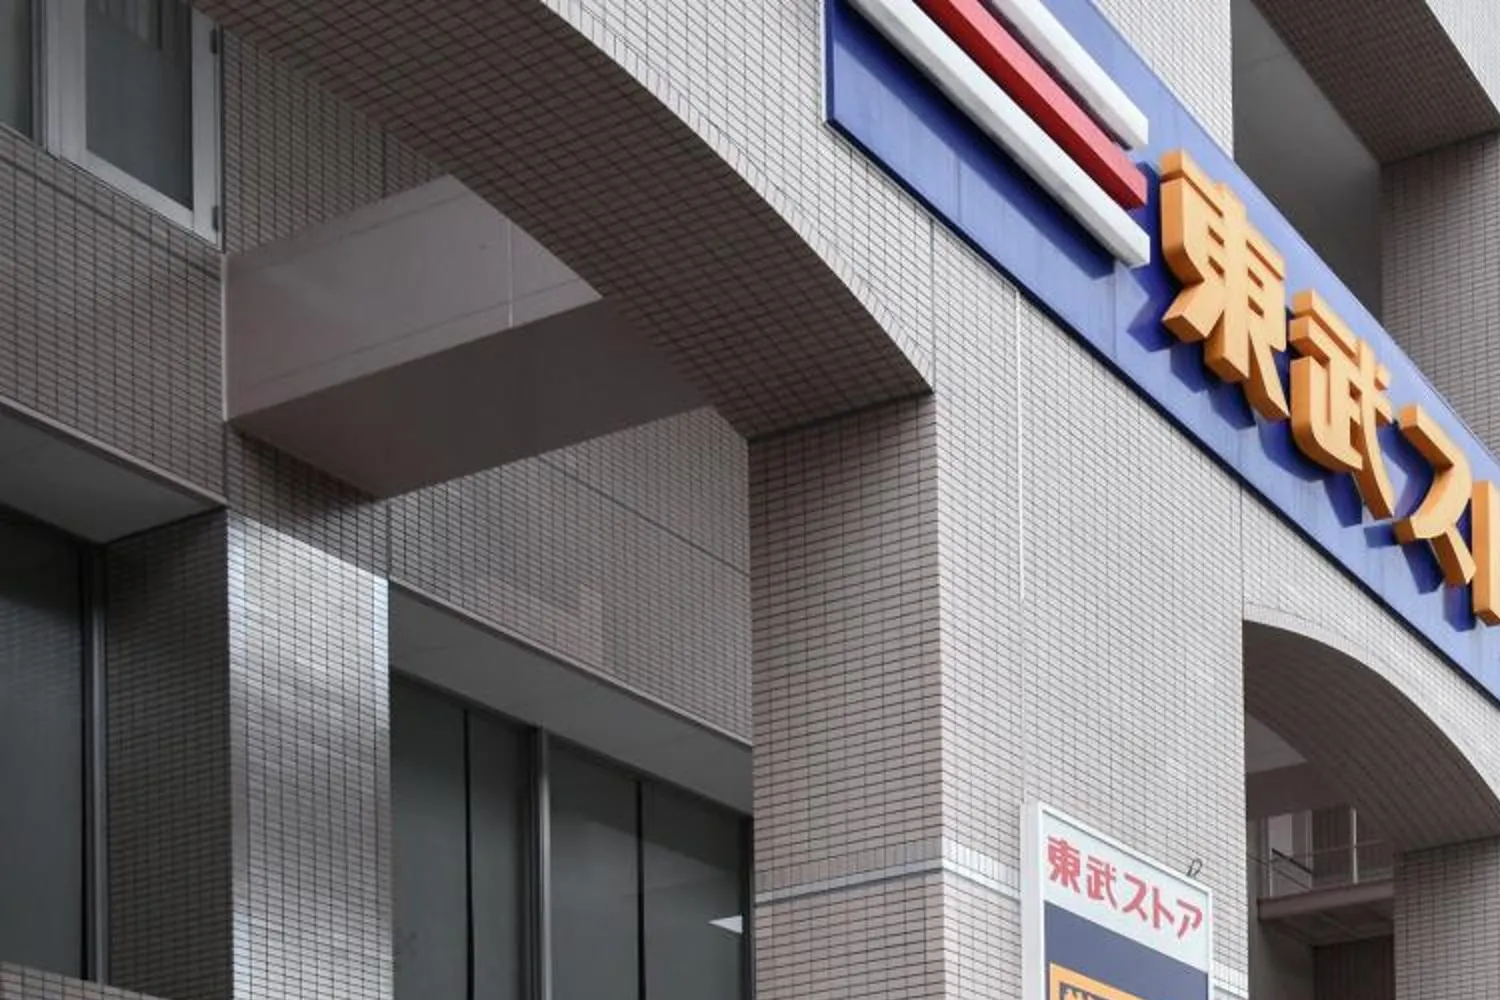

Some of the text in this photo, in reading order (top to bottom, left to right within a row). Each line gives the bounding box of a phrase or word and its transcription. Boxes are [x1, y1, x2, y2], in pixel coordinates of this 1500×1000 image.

[1047, 834, 1203, 939] 東武ストア
